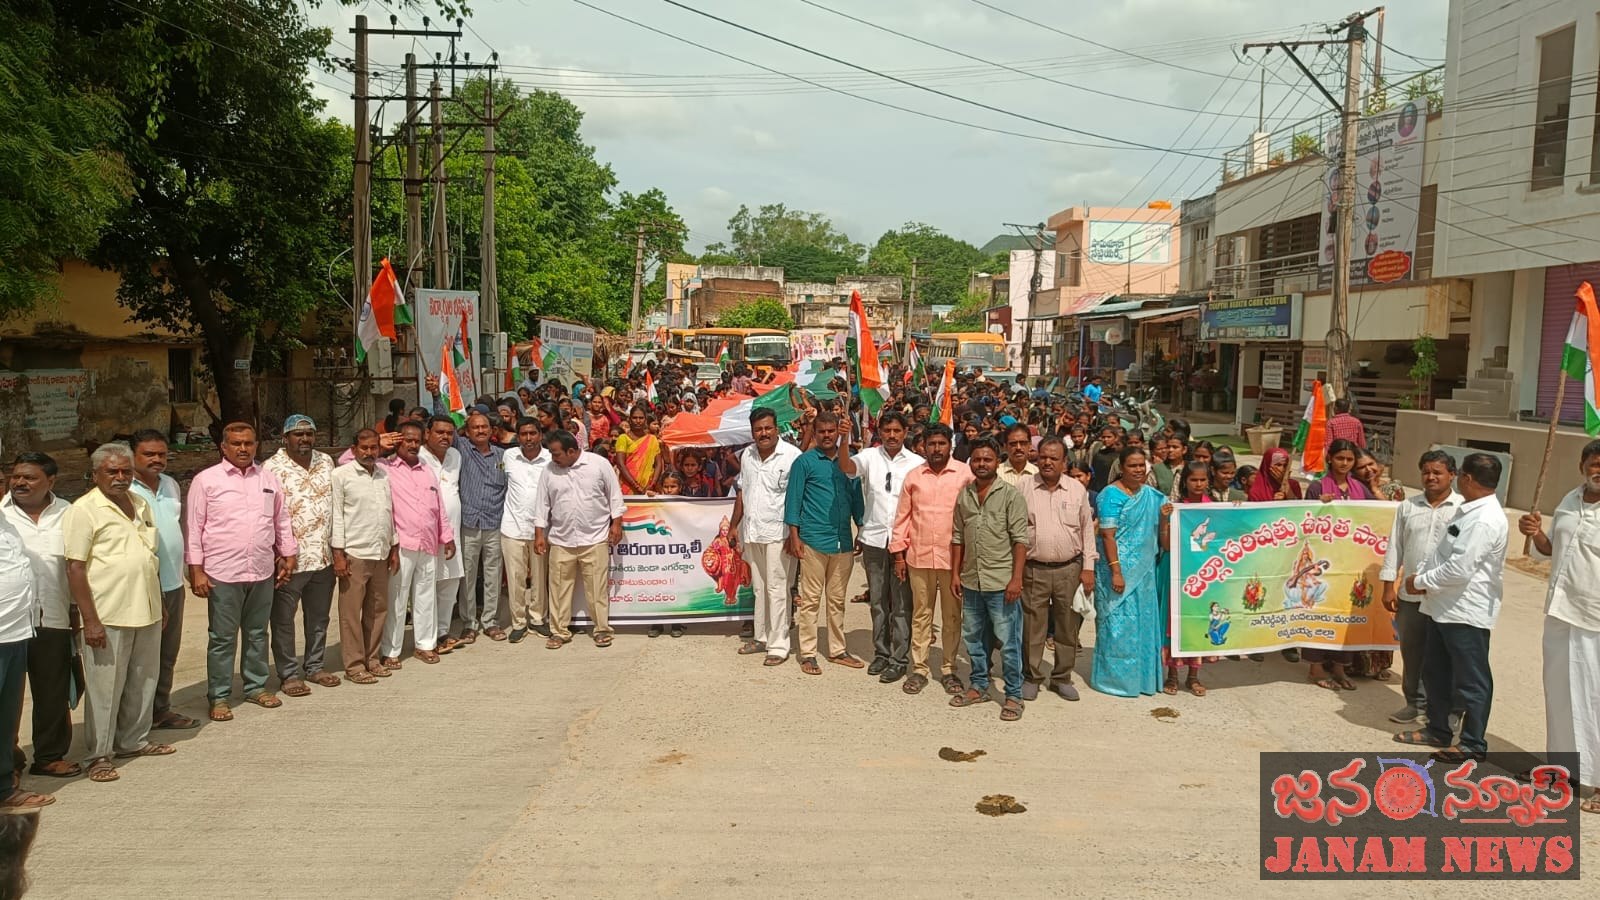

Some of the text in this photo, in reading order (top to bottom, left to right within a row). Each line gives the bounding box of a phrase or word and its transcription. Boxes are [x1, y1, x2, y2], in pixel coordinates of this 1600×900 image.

[617, 542, 666, 556] తిరంగా
[669, 539, 702, 559] ర్యాలీ
[1183, 556, 1233, 598] జిల్లా
[1220, 517, 1299, 563] పరిషత్తు
[1301, 512, 1351, 544] ఉన్నత
